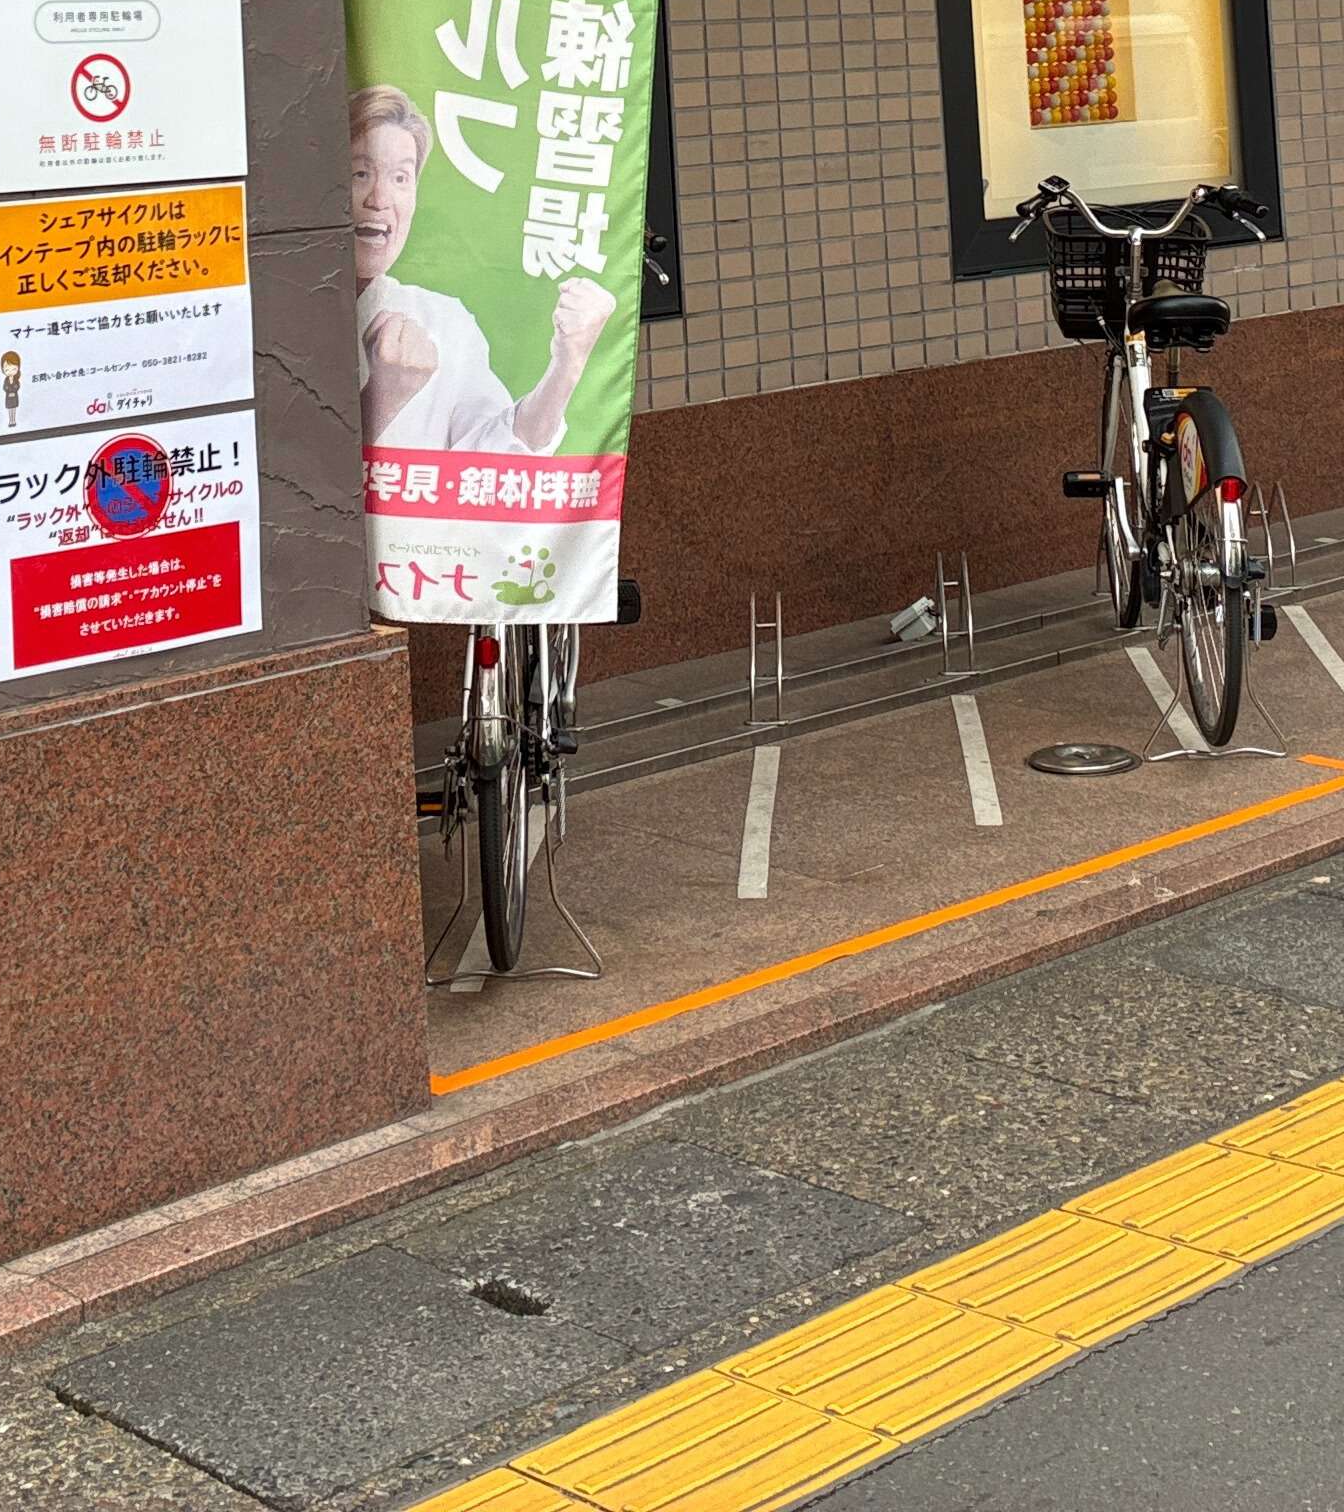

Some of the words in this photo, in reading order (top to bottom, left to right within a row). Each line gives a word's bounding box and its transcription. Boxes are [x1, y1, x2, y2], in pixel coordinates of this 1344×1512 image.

[53, 10, 144, 23] 利用者専用駐輪場
[39, 129, 166, 154] 無断駐輪禁止
[40, 200, 186, 233] シェアサイクルは
[17, 258, 209, 295] 正しくご返却ください。
[10, 302, 222, 339] マナー遵守にご協力をお願いいたします
[142, 352, 207, 369] 050-3821-8282
[116, 397, 153, 411] ダイチャリ
[80, 607, 181, 636] させていただきます。
